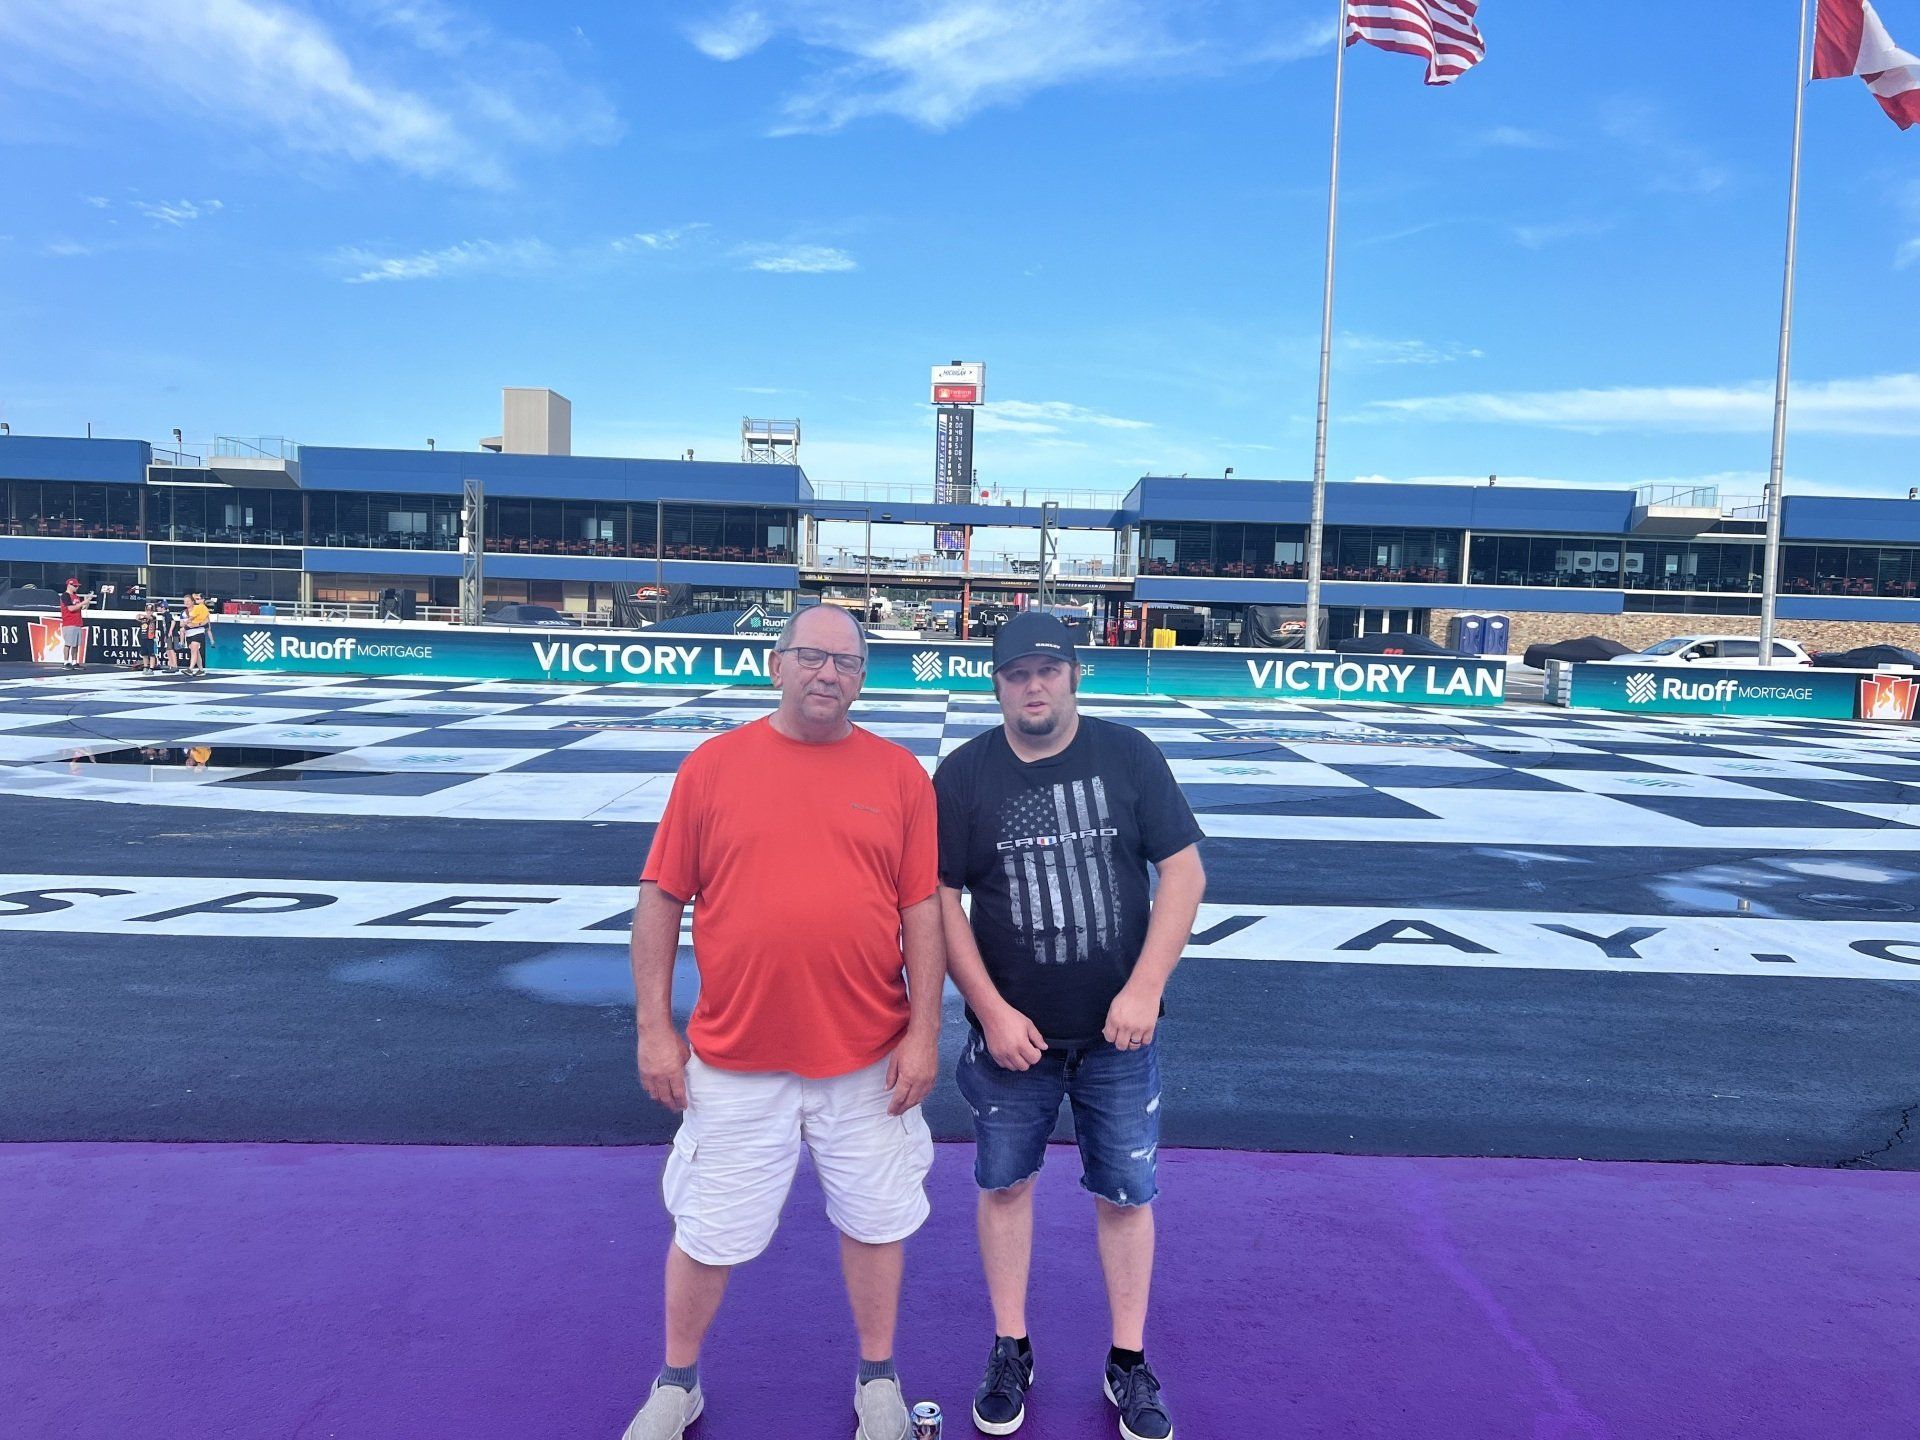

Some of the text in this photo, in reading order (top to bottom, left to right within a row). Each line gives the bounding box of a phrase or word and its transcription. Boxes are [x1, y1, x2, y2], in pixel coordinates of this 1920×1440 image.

[281, 636, 432, 659] Ruoff MORTGAGE
[532, 641, 702, 675] VICTORY
[1246, 659, 1504, 697] VICTORY LAN
[1662, 678, 1813, 702] Ruoff MORTGAGE
[0, 888, 636, 930] SPE
